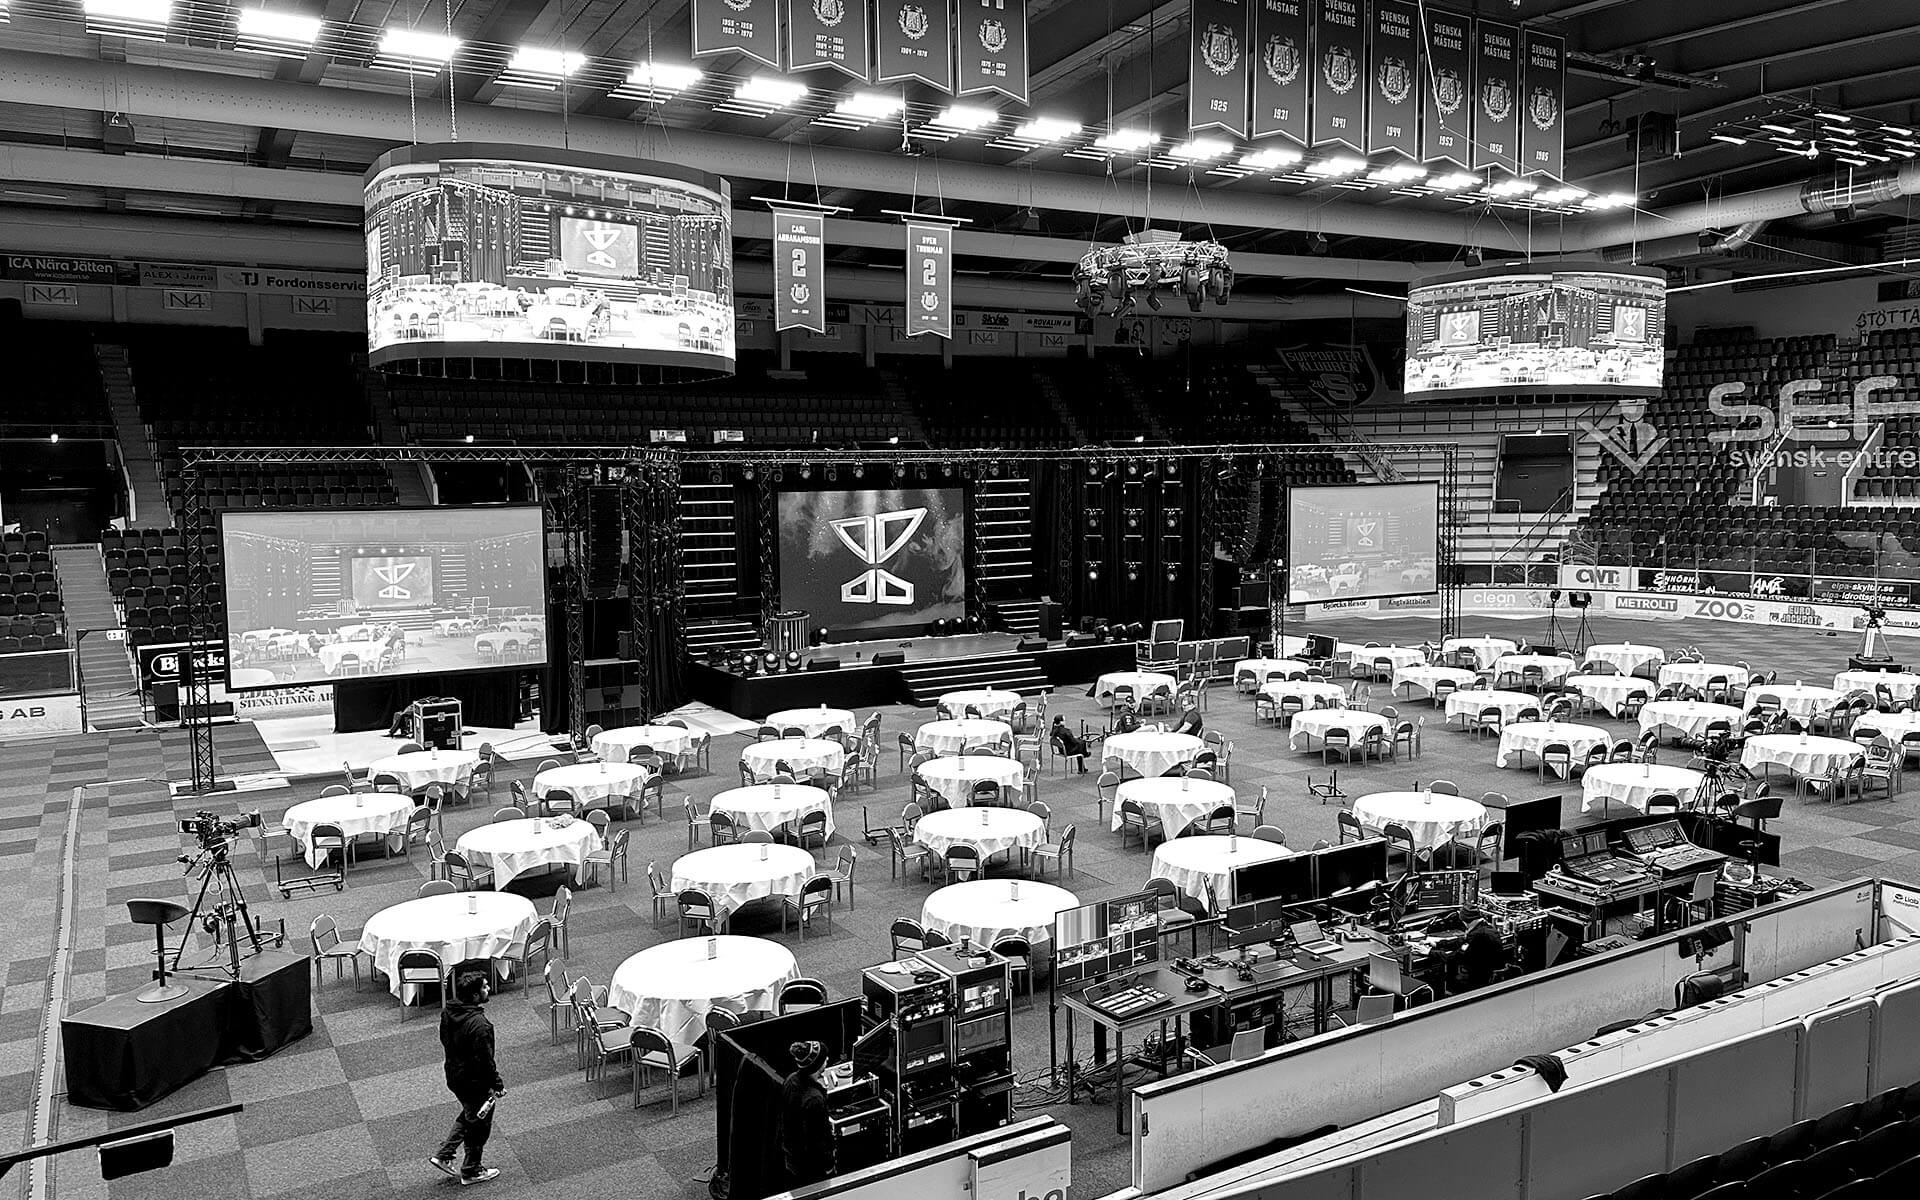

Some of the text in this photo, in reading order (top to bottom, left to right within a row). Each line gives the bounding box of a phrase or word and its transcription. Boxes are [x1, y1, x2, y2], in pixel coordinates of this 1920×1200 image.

[1380, 10, 1410, 25] SVENSKA
[1434, 23, 1462, 37] SVENSKA
[1484, 33, 1511, 47] SVENSKA
[1531, 44, 1557, 58] SVENSKA
[1210, 98, 1228, 112] 1925
[1273, 107, 1289, 121] 1931
[1332, 116, 1347, 129] 1941
[1386, 126, 1401, 137] 1944
[1439, 135, 1453, 147] 1953
[1489, 143, 1503, 153] 1956
[922, 236, 937, 245] SVEN
[8, 257, 114, 273] ICA Nära Jätten
[791, 248, 807, 277] 2
[241, 271, 259, 286] TJ
[923, 258, 937, 286] 2
[33, 286, 71, 303] N4
[169, 291, 206, 309] N4
[298, 297, 332, 314] N4
[865, 307, 894, 324] N4
[975, 332, 995, 344] N4
[1045, 336, 1064, 346] N4
[1286, 351, 1362, 362] SUPPORTER
[1298, 361, 1361, 374] KLUBBEN
[1831, 582, 1894, 593] elpa-skyltr.se
[1474, 591, 1515, 604] clean
[1617, 598, 1677, 611] METROLIT
[1788, 605, 1814, 615] EURO
[1781, 612, 1822, 625] JACKPOT
